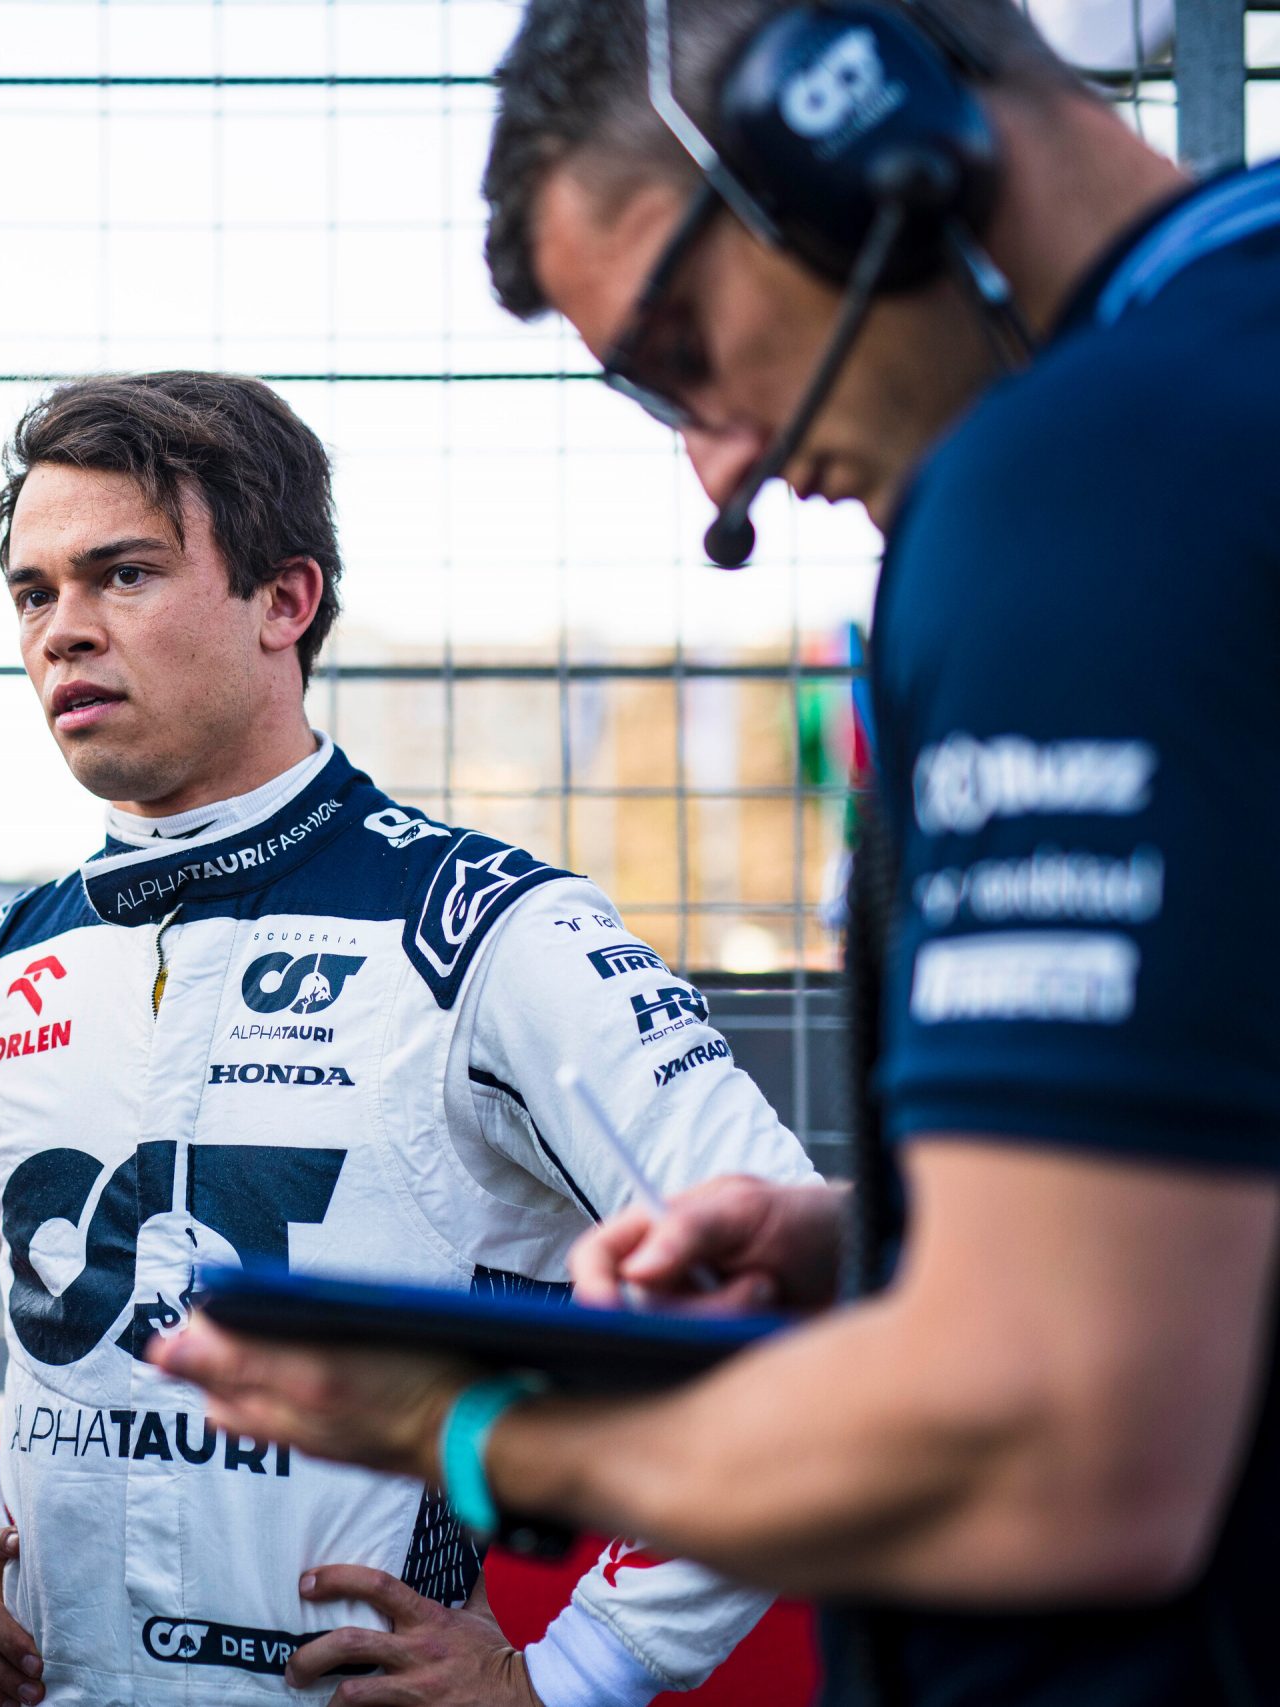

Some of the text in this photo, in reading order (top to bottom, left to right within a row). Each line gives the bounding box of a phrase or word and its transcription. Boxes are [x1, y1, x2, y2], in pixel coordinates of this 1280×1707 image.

[253, 932, 357, 945] SCUDERIA
[586, 944, 672, 980] PIRE
[229, 1025, 334, 1043] ALPHATAURI
[208, 1063, 356, 1087] HONDA
[221, 1635, 255, 1662] DE
